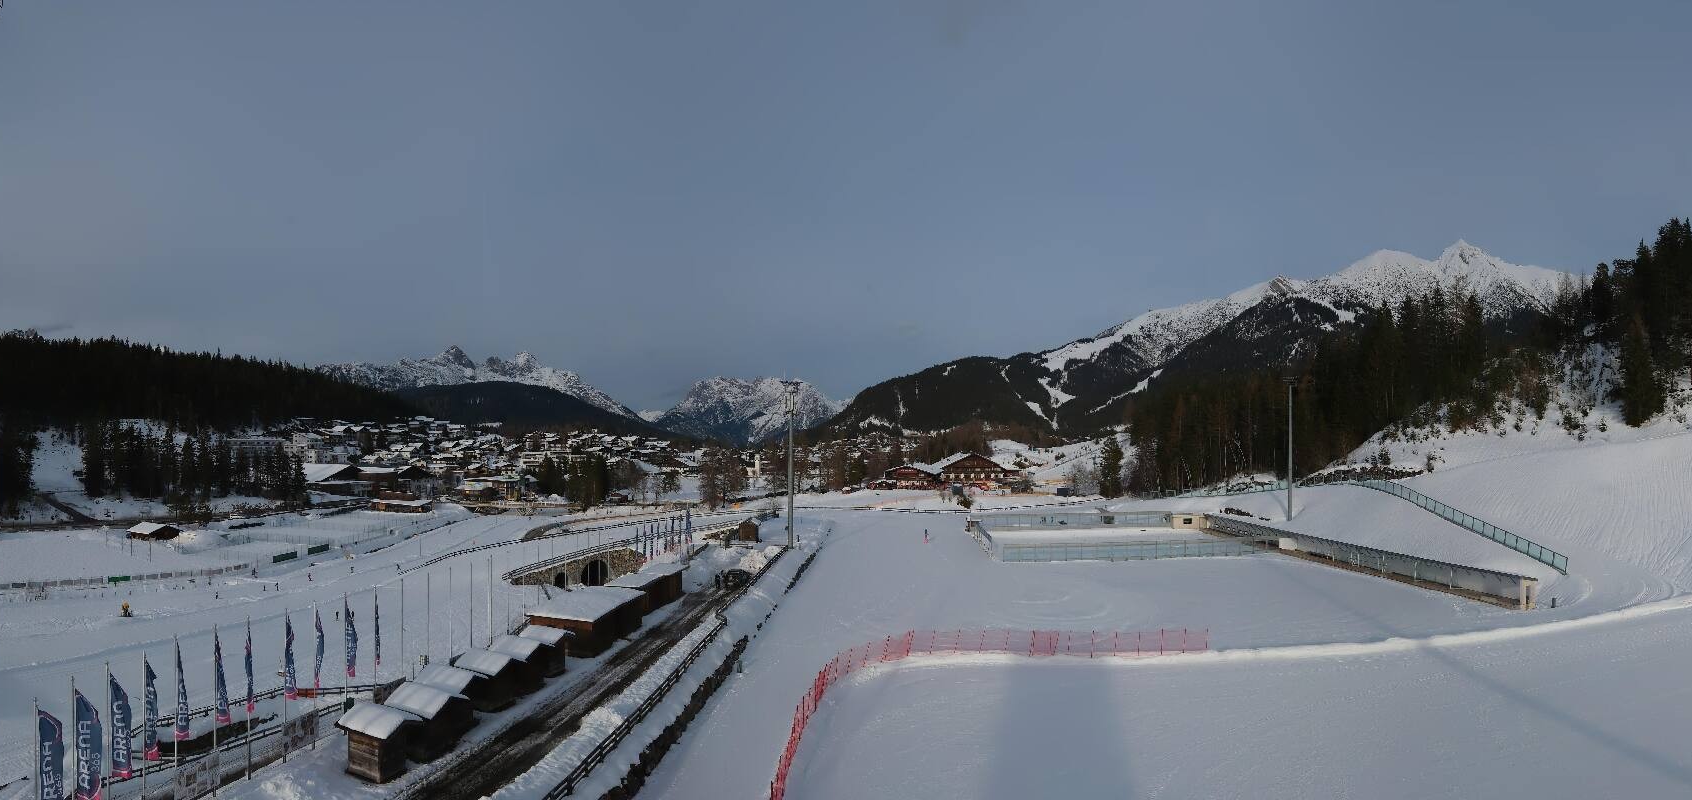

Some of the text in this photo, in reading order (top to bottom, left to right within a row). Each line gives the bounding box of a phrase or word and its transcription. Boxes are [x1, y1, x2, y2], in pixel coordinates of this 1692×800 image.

[78, 720, 92, 790] ARENA
[113, 700, 127, 763] ARENA
[42, 741, 57, 800] RENA
[91, 752, 100, 773] 365
